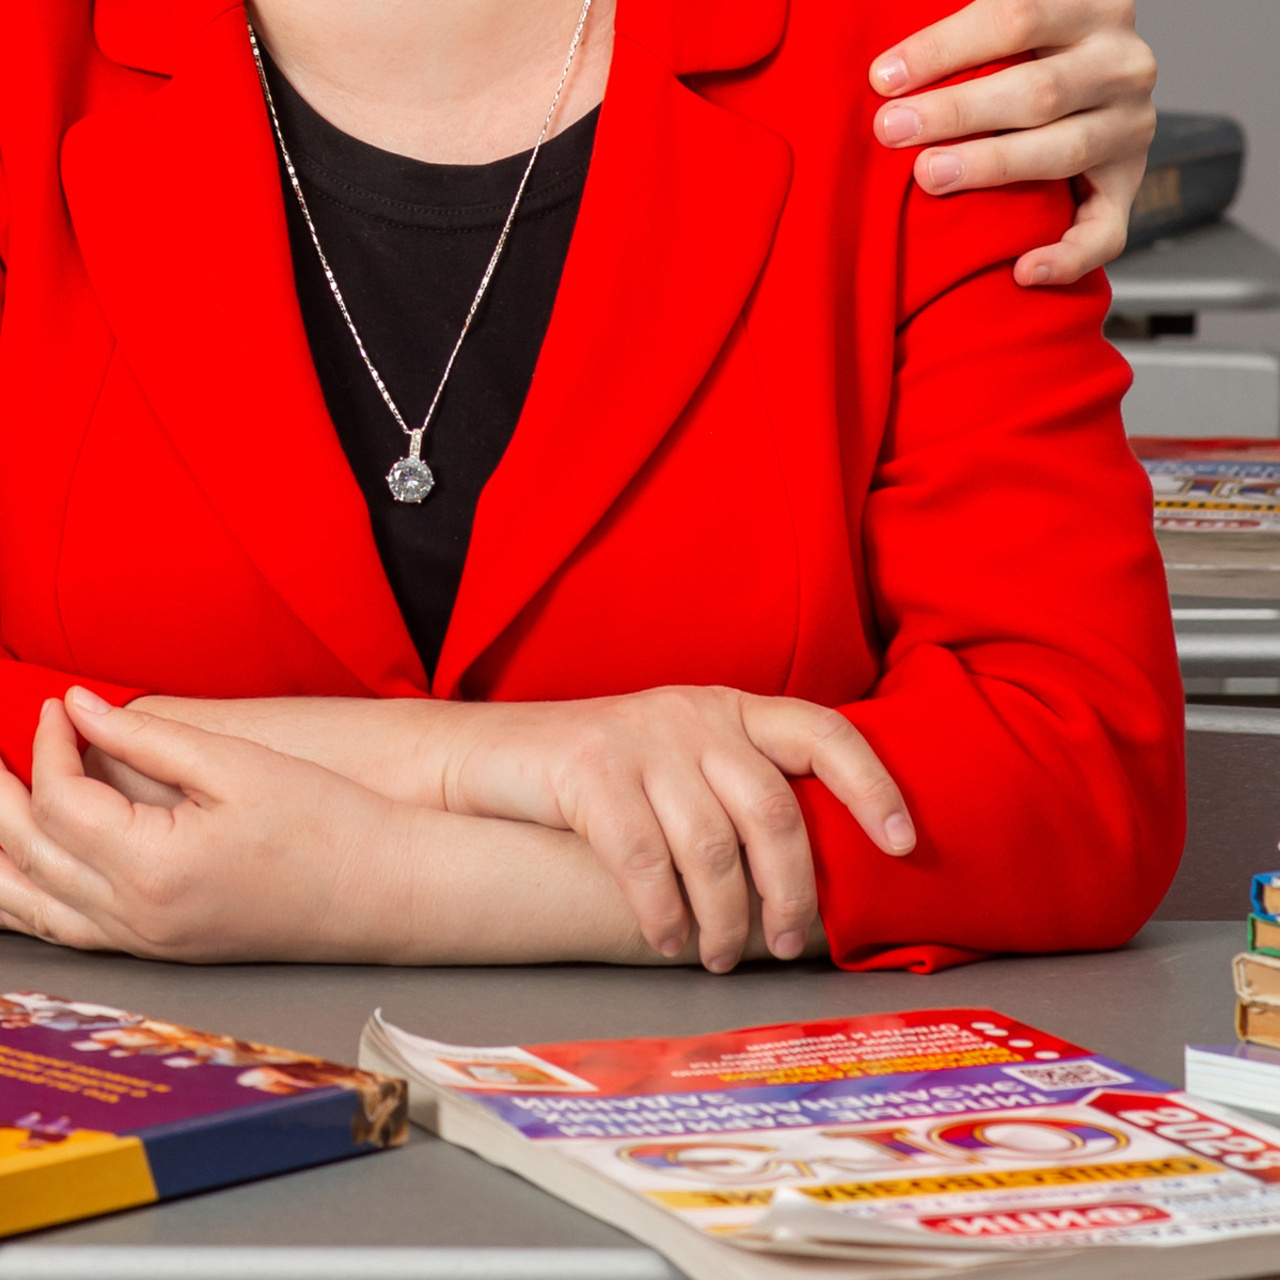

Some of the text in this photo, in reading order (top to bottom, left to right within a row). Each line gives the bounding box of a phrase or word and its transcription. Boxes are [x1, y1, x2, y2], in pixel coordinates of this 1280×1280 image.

[511, 1091, 736, 1114] ЗАДАНИЙ
[544, 1080, 1027, 1126] ЭКЗАМЕНАЦИОННЫХ
[559, 1092, 1056, 1137] ТИПОВЫЕ ВАРИАНТЫ
[617, 1116, 1130, 1186] ОГЭ
[1117, 1108, 1280, 1172] 2023
[705, 1157, 1204, 1207] ОБЩЕСТВОЗНАИЕ
[952, 1204, 1144, 1237] ФИПИ
